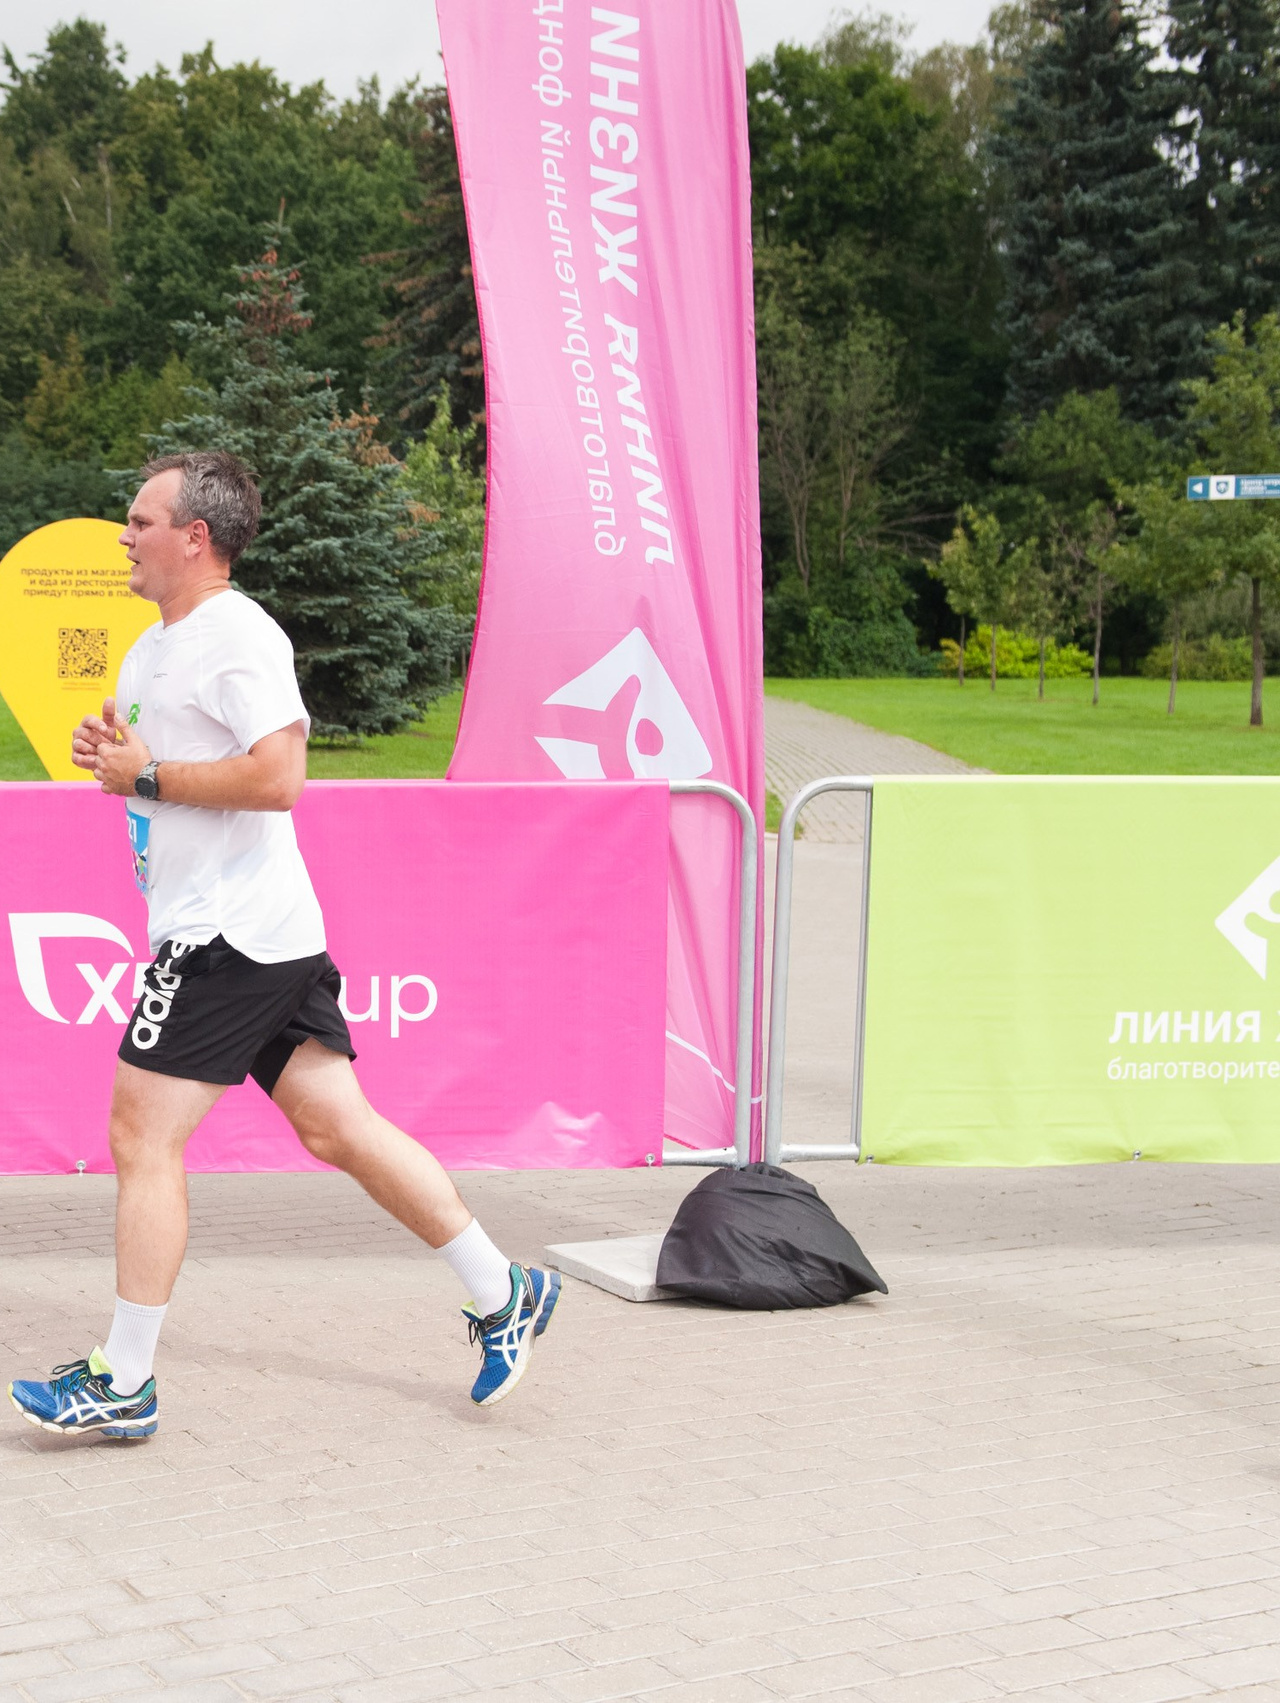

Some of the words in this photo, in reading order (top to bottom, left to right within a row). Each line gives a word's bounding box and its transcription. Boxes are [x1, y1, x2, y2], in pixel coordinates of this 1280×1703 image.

[21, 568, 73, 576] продукты
[75, 580, 129, 588] ресторан
[23, 588, 68, 597] приедут
[71, 589, 105, 598] прямо
[116, 591, 141, 599] пар
